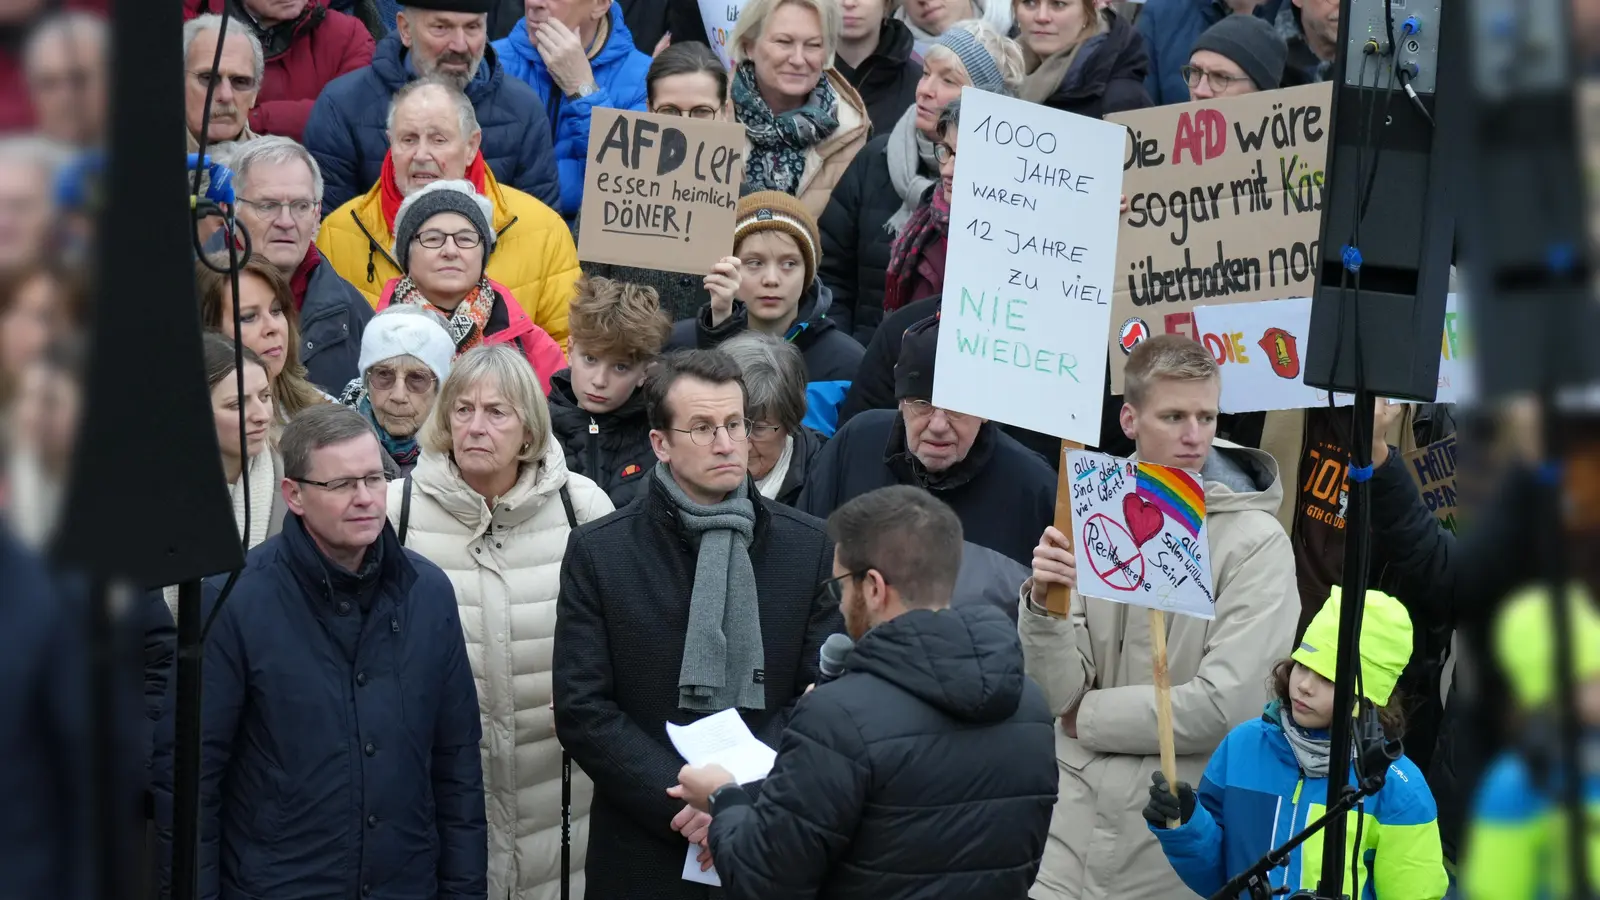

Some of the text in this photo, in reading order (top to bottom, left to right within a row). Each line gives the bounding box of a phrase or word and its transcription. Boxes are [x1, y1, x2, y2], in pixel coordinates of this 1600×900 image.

[973, 115, 1057, 154] 1000
[1171, 108, 1227, 166] AfD
[1233, 103, 1324, 154] wäre
[597, 172, 737, 211] essen heimlich
[1014, 156, 1094, 194] JAHRE
[972, 181, 1037, 211] WAREN
[1127, 182, 1224, 246] sogar
[1230, 159, 1272, 216] mit
[604, 199, 692, 242] DÖNER!
[966, 218, 1088, 263] 12 JAHRE
[1128, 240, 1260, 307] überbacken
[1202, 331, 1250, 366] DIE
